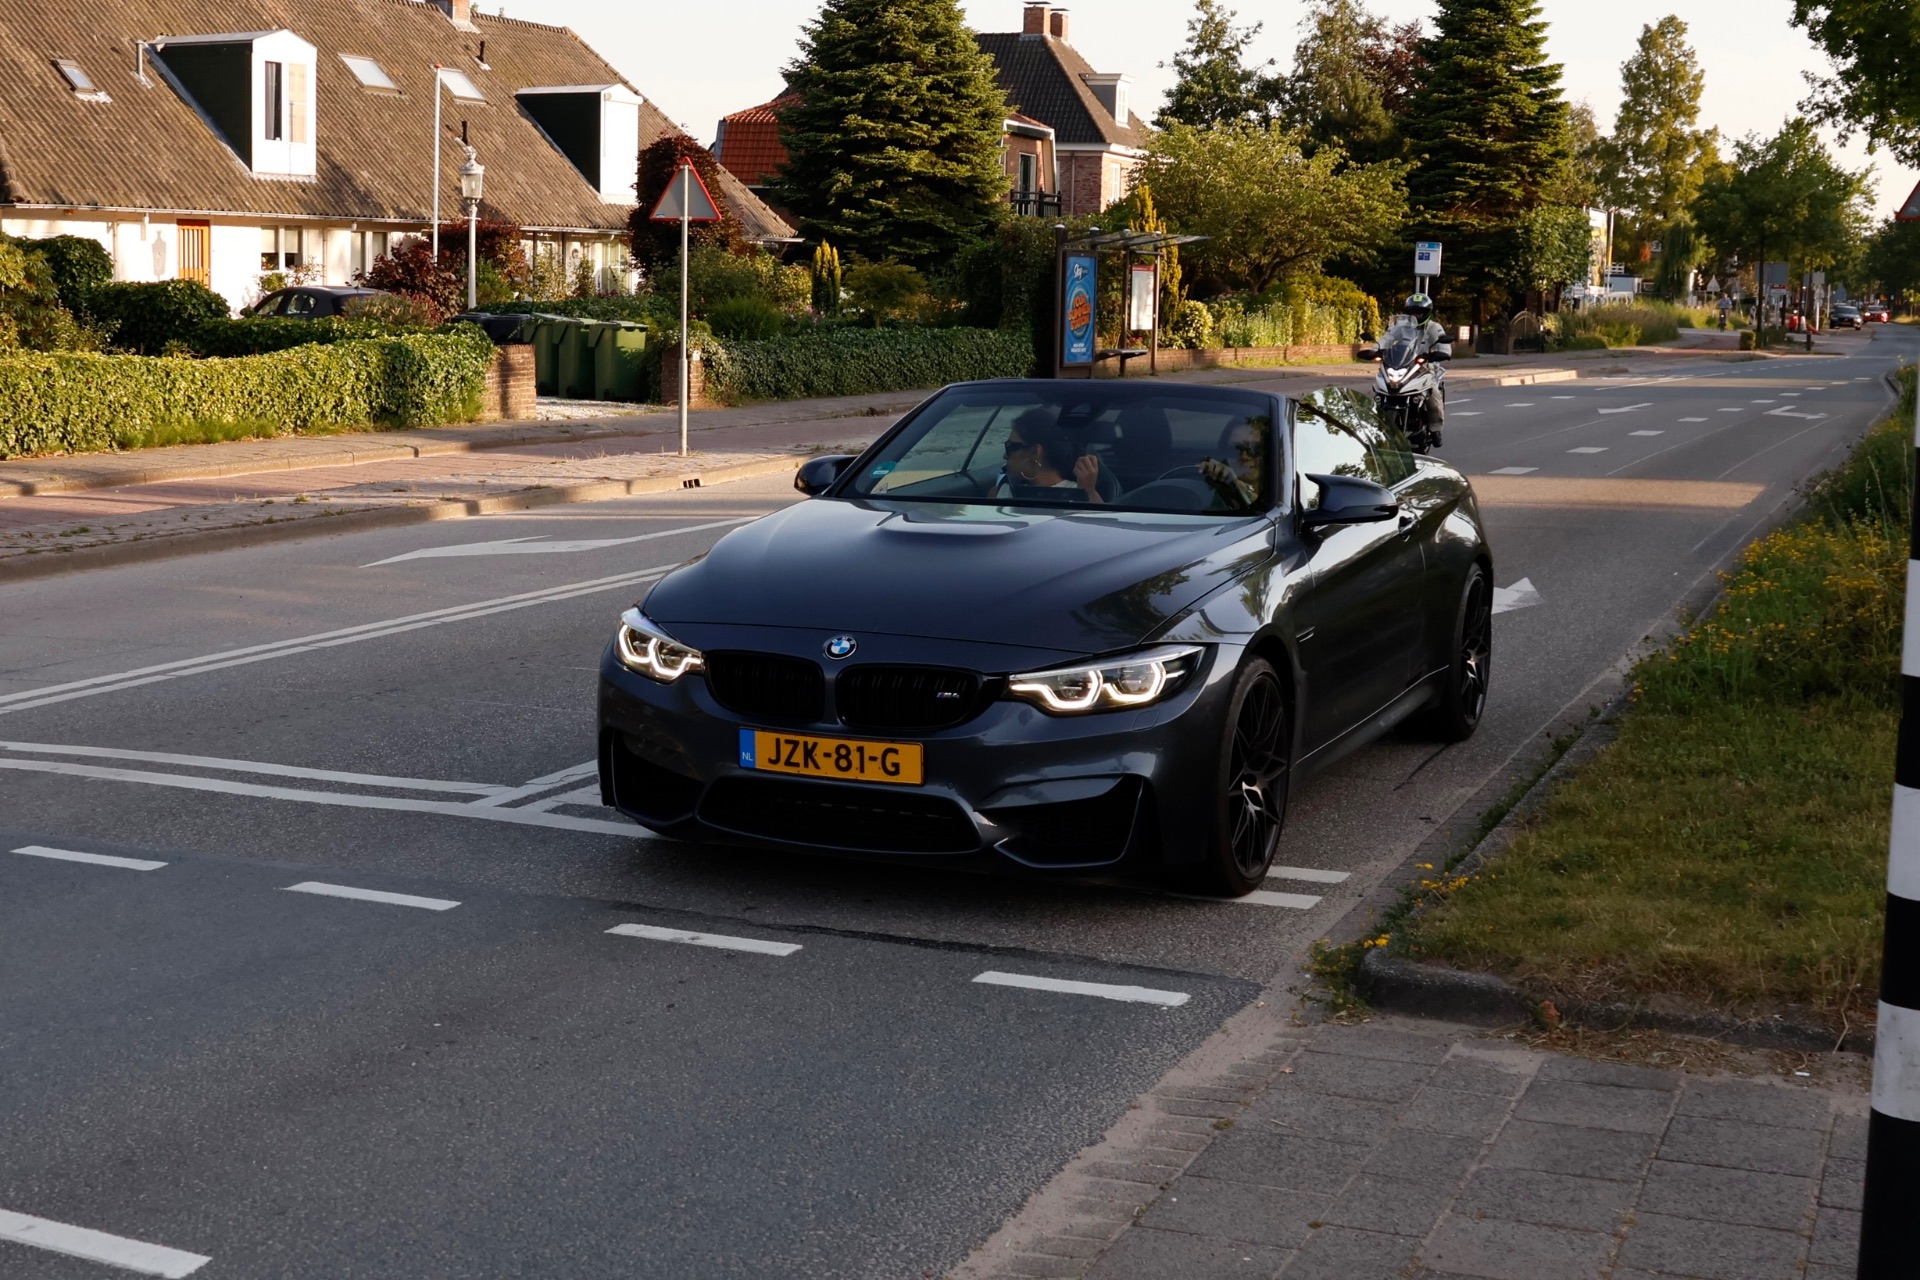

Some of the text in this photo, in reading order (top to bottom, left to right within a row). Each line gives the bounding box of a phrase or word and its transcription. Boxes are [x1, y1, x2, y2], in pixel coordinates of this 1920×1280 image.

[831, 636, 856, 645] BMW
[741, 737, 901, 777] NL JZK-81-G
